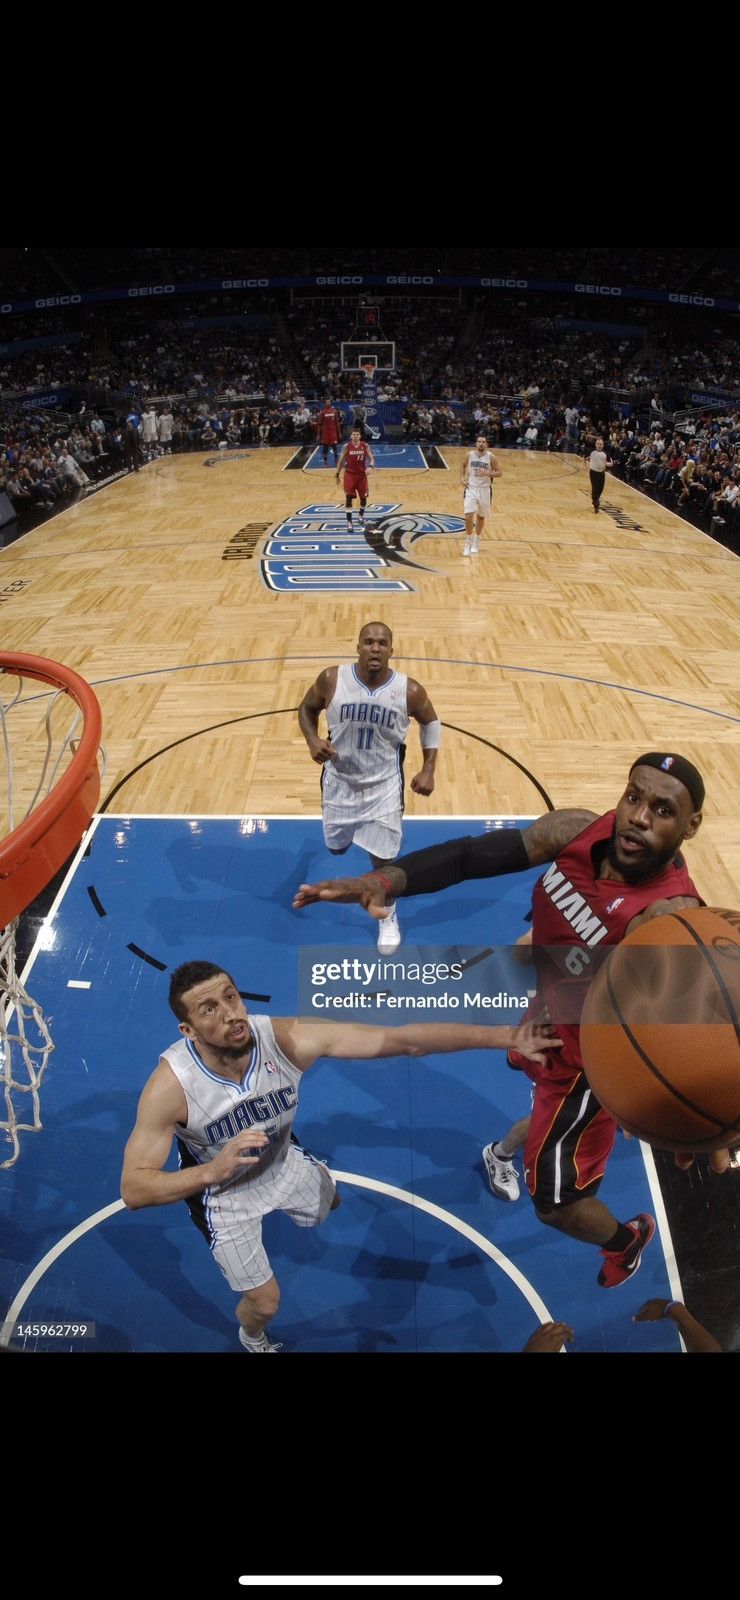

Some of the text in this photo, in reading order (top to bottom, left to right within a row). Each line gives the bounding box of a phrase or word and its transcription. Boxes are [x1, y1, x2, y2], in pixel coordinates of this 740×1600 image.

[221, 278, 270, 290] GEICO
[315, 275, 364, 286] GEICO
[386, 275, 435, 286] GEICO
[480, 277, 529, 289] GEICO
[127, 284, 177, 298] GEICO
[574, 283, 623, 297] GEICO
[34, 293, 82, 309] GEICO
[668, 292, 717, 308] GEICO
[221, 522, 273, 561] ORLANDO
[260, 503, 414, 592] MAGIC
[340, 702, 397, 729] MAGIC
[357, 727, 374, 751] 11
[543, 861, 608, 950] MIAMI
[565, 946, 591, 976] 6
[204, 1085, 298, 1145] MAGIC
